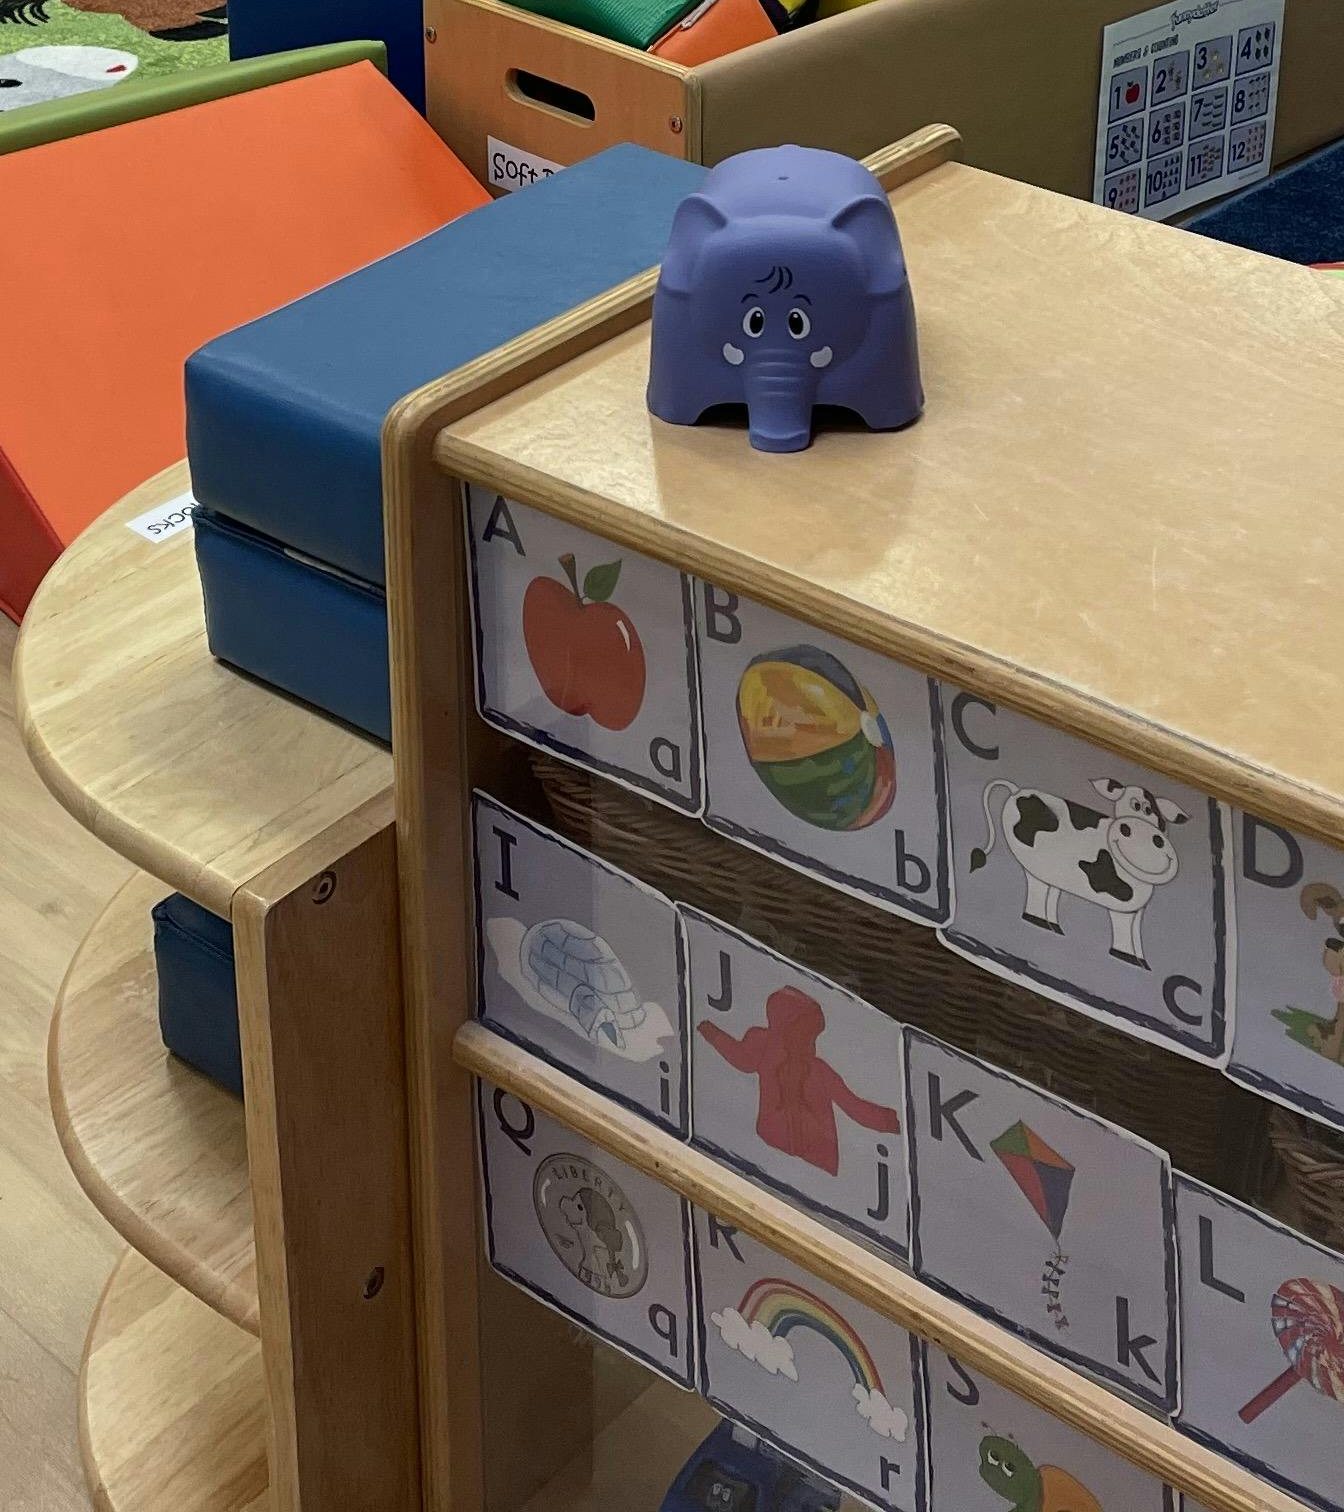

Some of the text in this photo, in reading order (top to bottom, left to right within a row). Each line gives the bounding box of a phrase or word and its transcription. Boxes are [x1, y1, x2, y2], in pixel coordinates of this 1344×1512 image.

[1197, 47, 1207, 70] 3
[1240, 36, 1251, 61] 4
[1113, 87, 1121, 110] 1
[1156, 70, 1167, 93] 2
[1235, 89, 1245, 113] 8
[1152, 120, 1162, 142] 6
[1194, 99, 1204, 123] 7
[493, 152, 538, 186] Soft
[1109, 137, 1119, 160] 5
[1190, 155, 1202, 178] 11
[1232, 140, 1245, 163] 12
[1108, 187, 1117, 210] 9
[1148, 171, 1162, 195] 10
[482, 494, 526, 557] A
[704, 582, 742, 645] B
[951, 691, 1000, 761] C
[649, 735, 682, 784] a
[493, 826, 520, 901] I
[895, 829, 931, 894] b
[1243, 814, 1304, 889] D
[707, 951, 733, 1013] J
[658, 1061, 670, 1115] i
[494, 1088, 535, 1157] Q
[928, 1074, 984, 1162] K
[552, 1165, 624, 1212] LIBERTY
[867, 1145, 889, 1222] j
[1199, 1215, 1246, 1304] L
[648, 1303, 678, 1359] q
[1116, 1296, 1163, 1386] k
[880, 1455, 901, 1491] r
